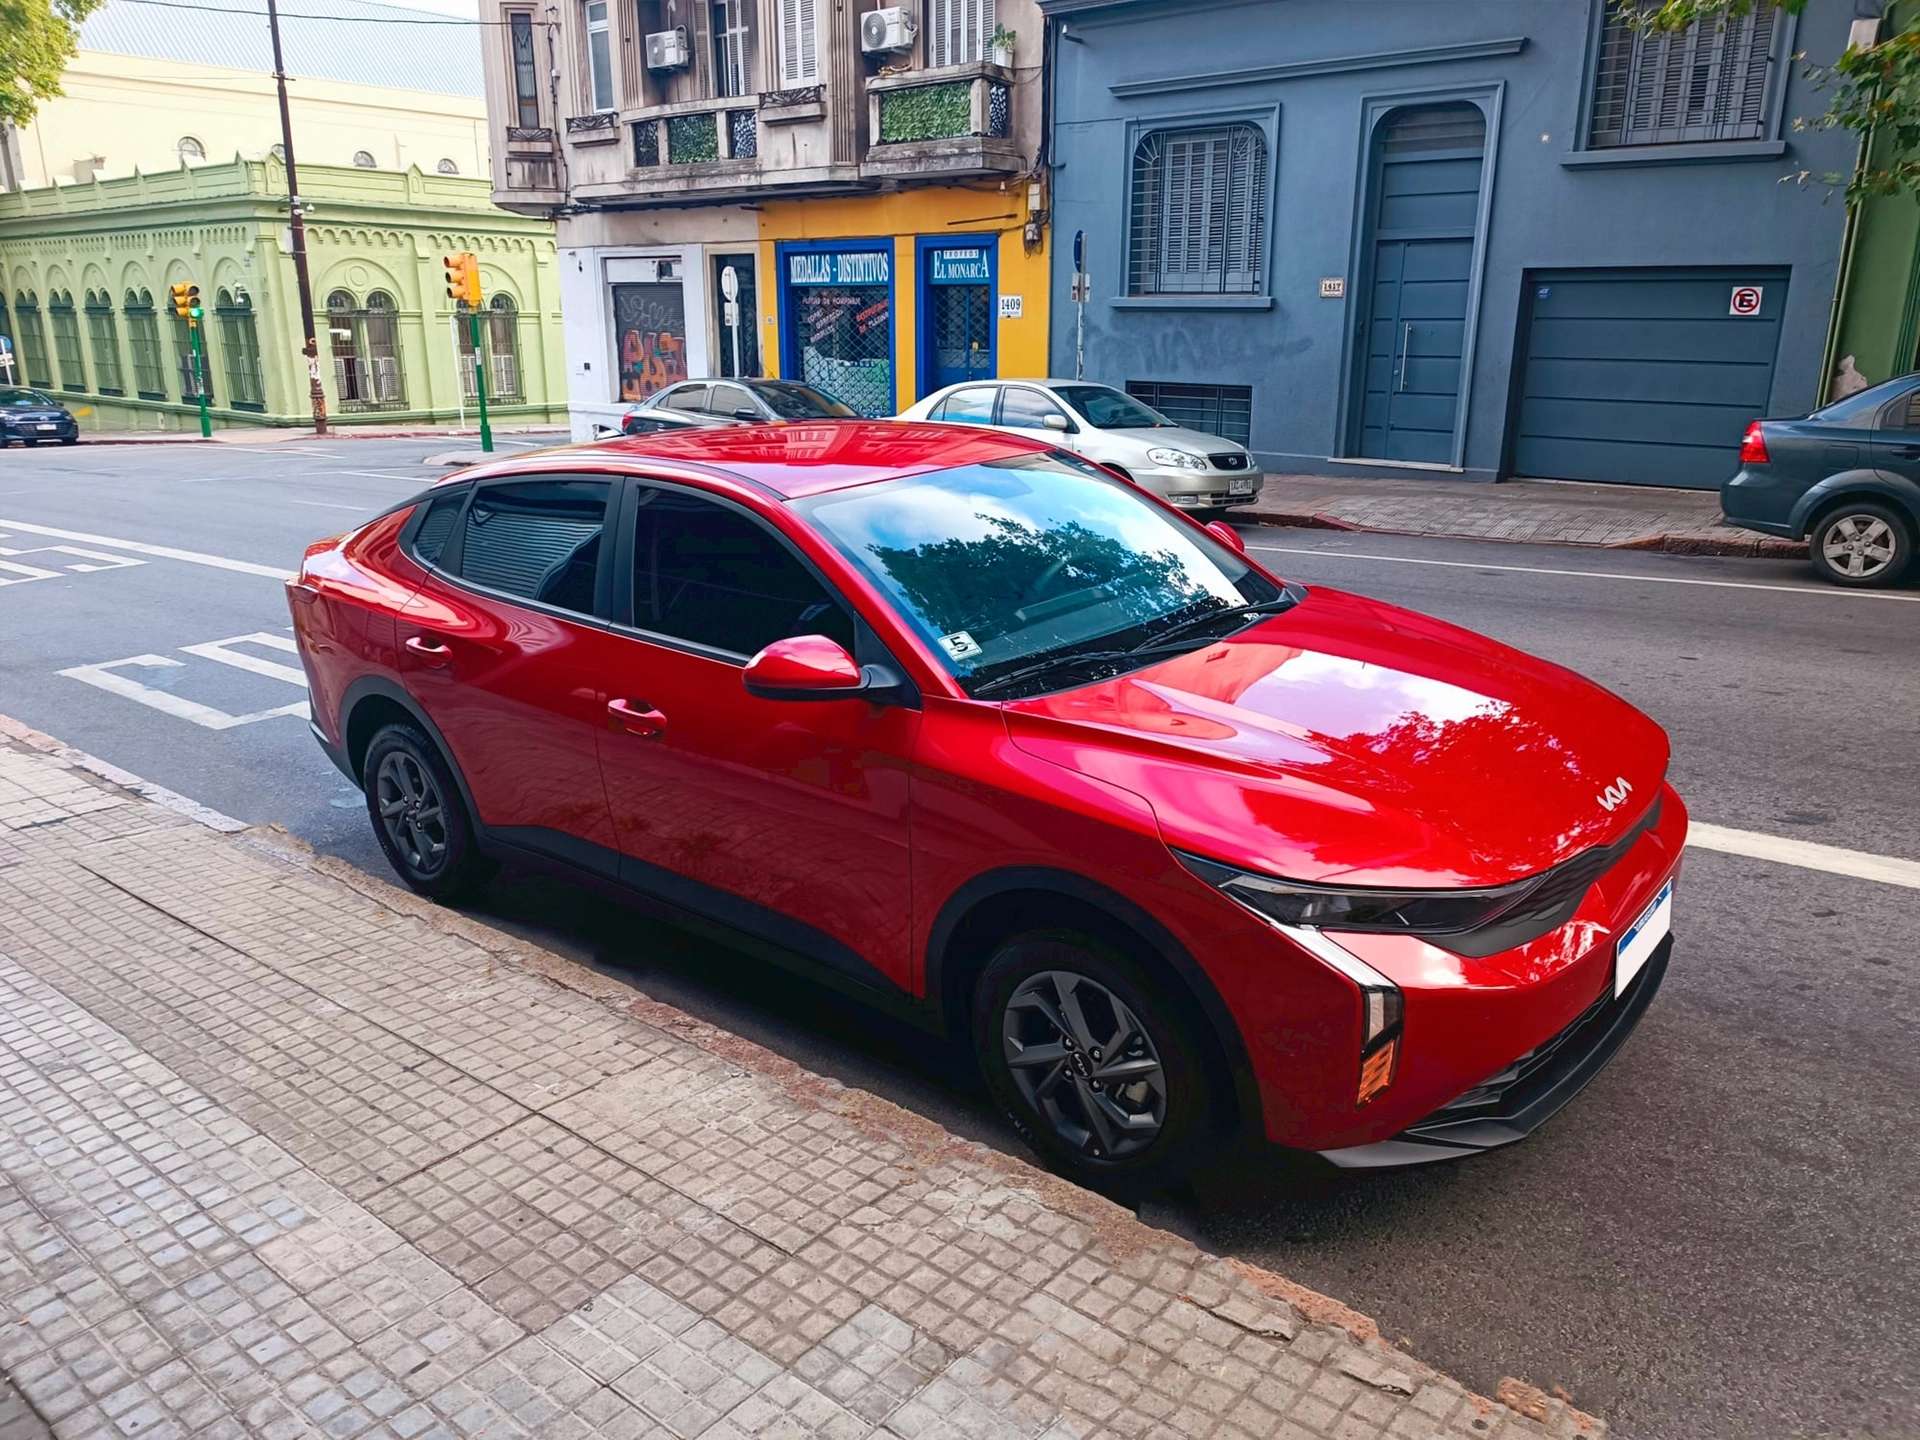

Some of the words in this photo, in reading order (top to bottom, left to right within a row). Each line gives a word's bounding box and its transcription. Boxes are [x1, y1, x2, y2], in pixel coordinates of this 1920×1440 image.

[944, 250, 978, 258] TROFEOS
[790, 254, 831, 283] MEDALLAS
[837, 252, 889, 282] DISTINTIVOS
[948, 249, 990, 278] MONARCA
[1001, 298, 1021, 310] 1409
[1739, 293, 1754, 308] E
[950, 635, 969, 653] 5
[1596, 777, 1633, 811] KIA
